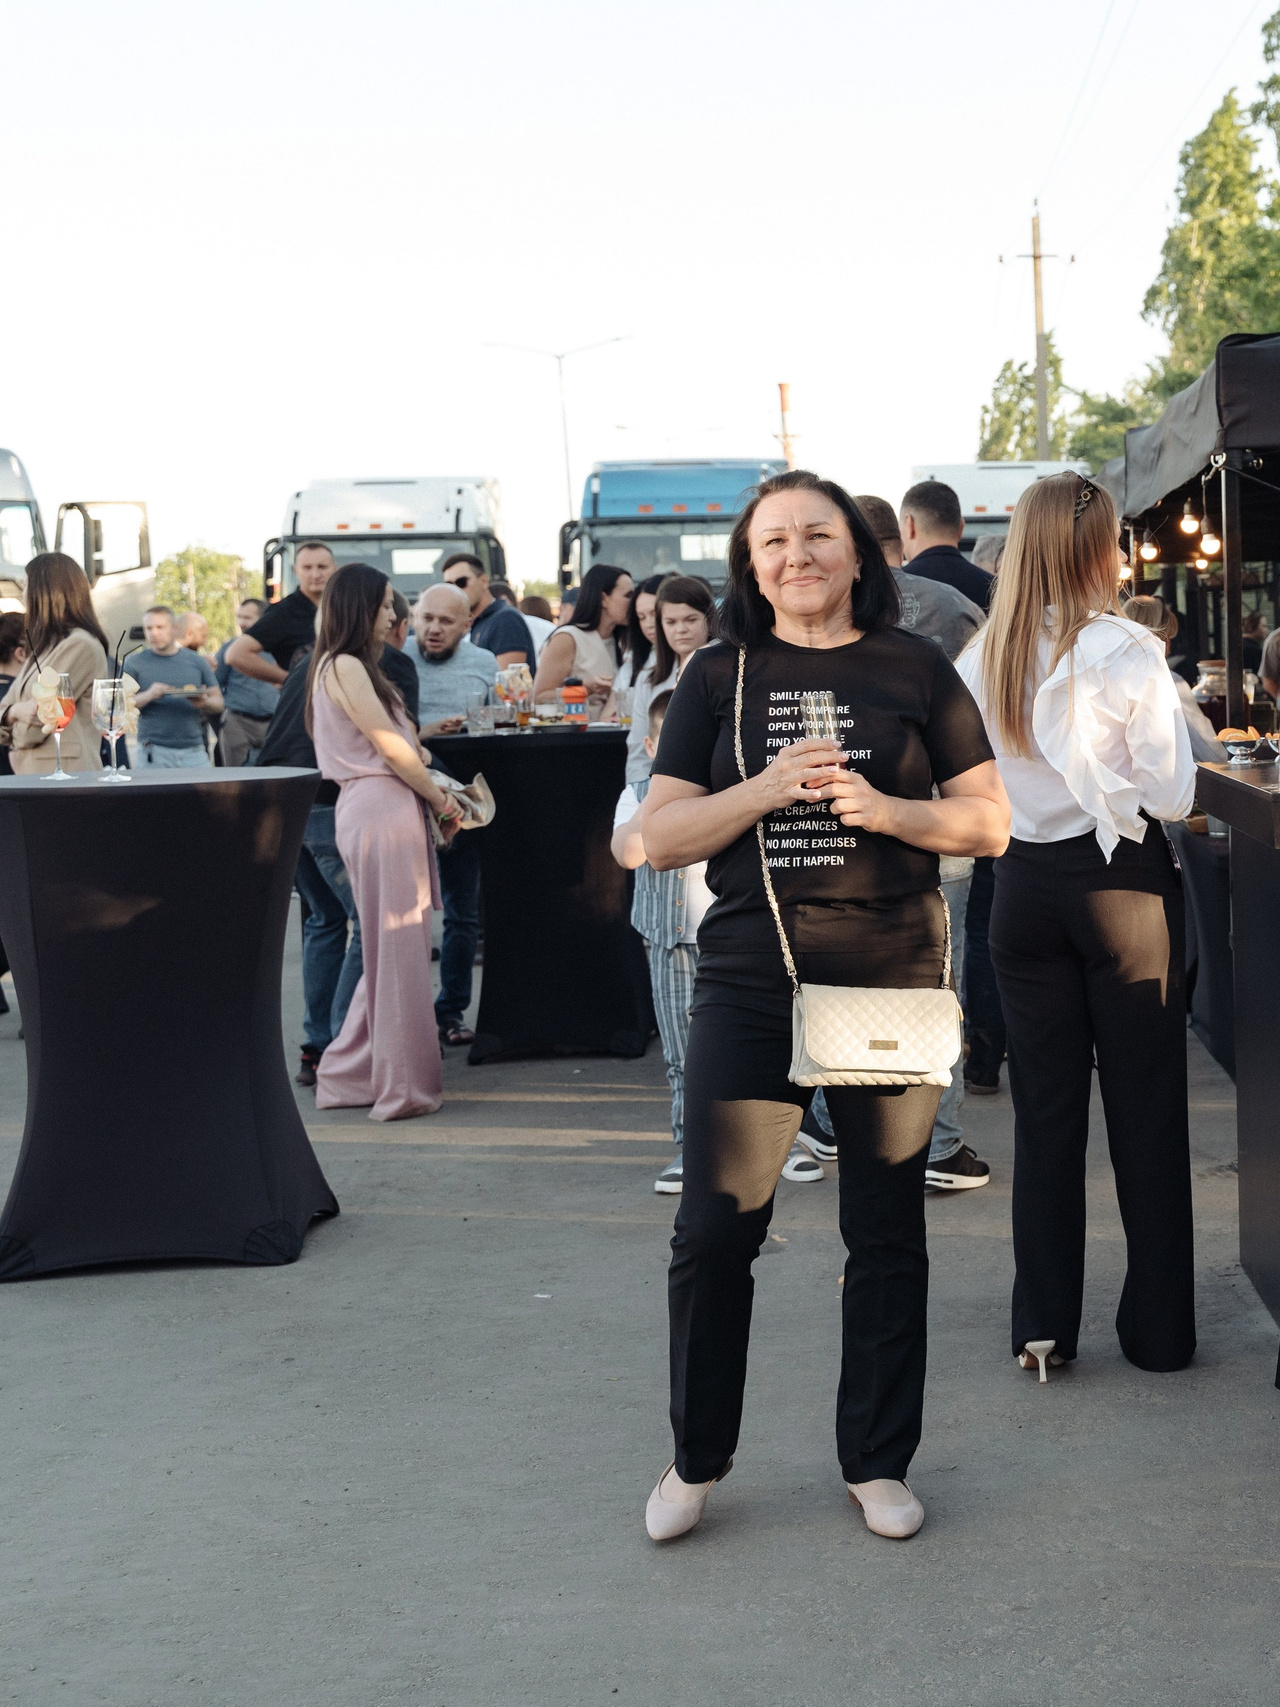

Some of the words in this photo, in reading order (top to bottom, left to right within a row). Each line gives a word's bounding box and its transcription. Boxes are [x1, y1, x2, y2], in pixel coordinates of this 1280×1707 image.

[769, 691, 801, 701] SMILE
[768, 706, 800, 716] DON'T
[767, 721, 796, 731] OPEN
[766, 738, 791, 748] FIND
[785, 802, 828, 816] CREATIVE
[769, 822, 793, 832] TAKE
[792, 820, 838, 831] CHANCES
[766, 839, 780, 850] NO
[781, 838, 809, 849] MORE
[811, 837, 857, 849] EXCUSES
[766, 857, 791, 868] MAKE
[792, 856, 802, 867] IT
[803, 855, 845, 867] HAPPEN
